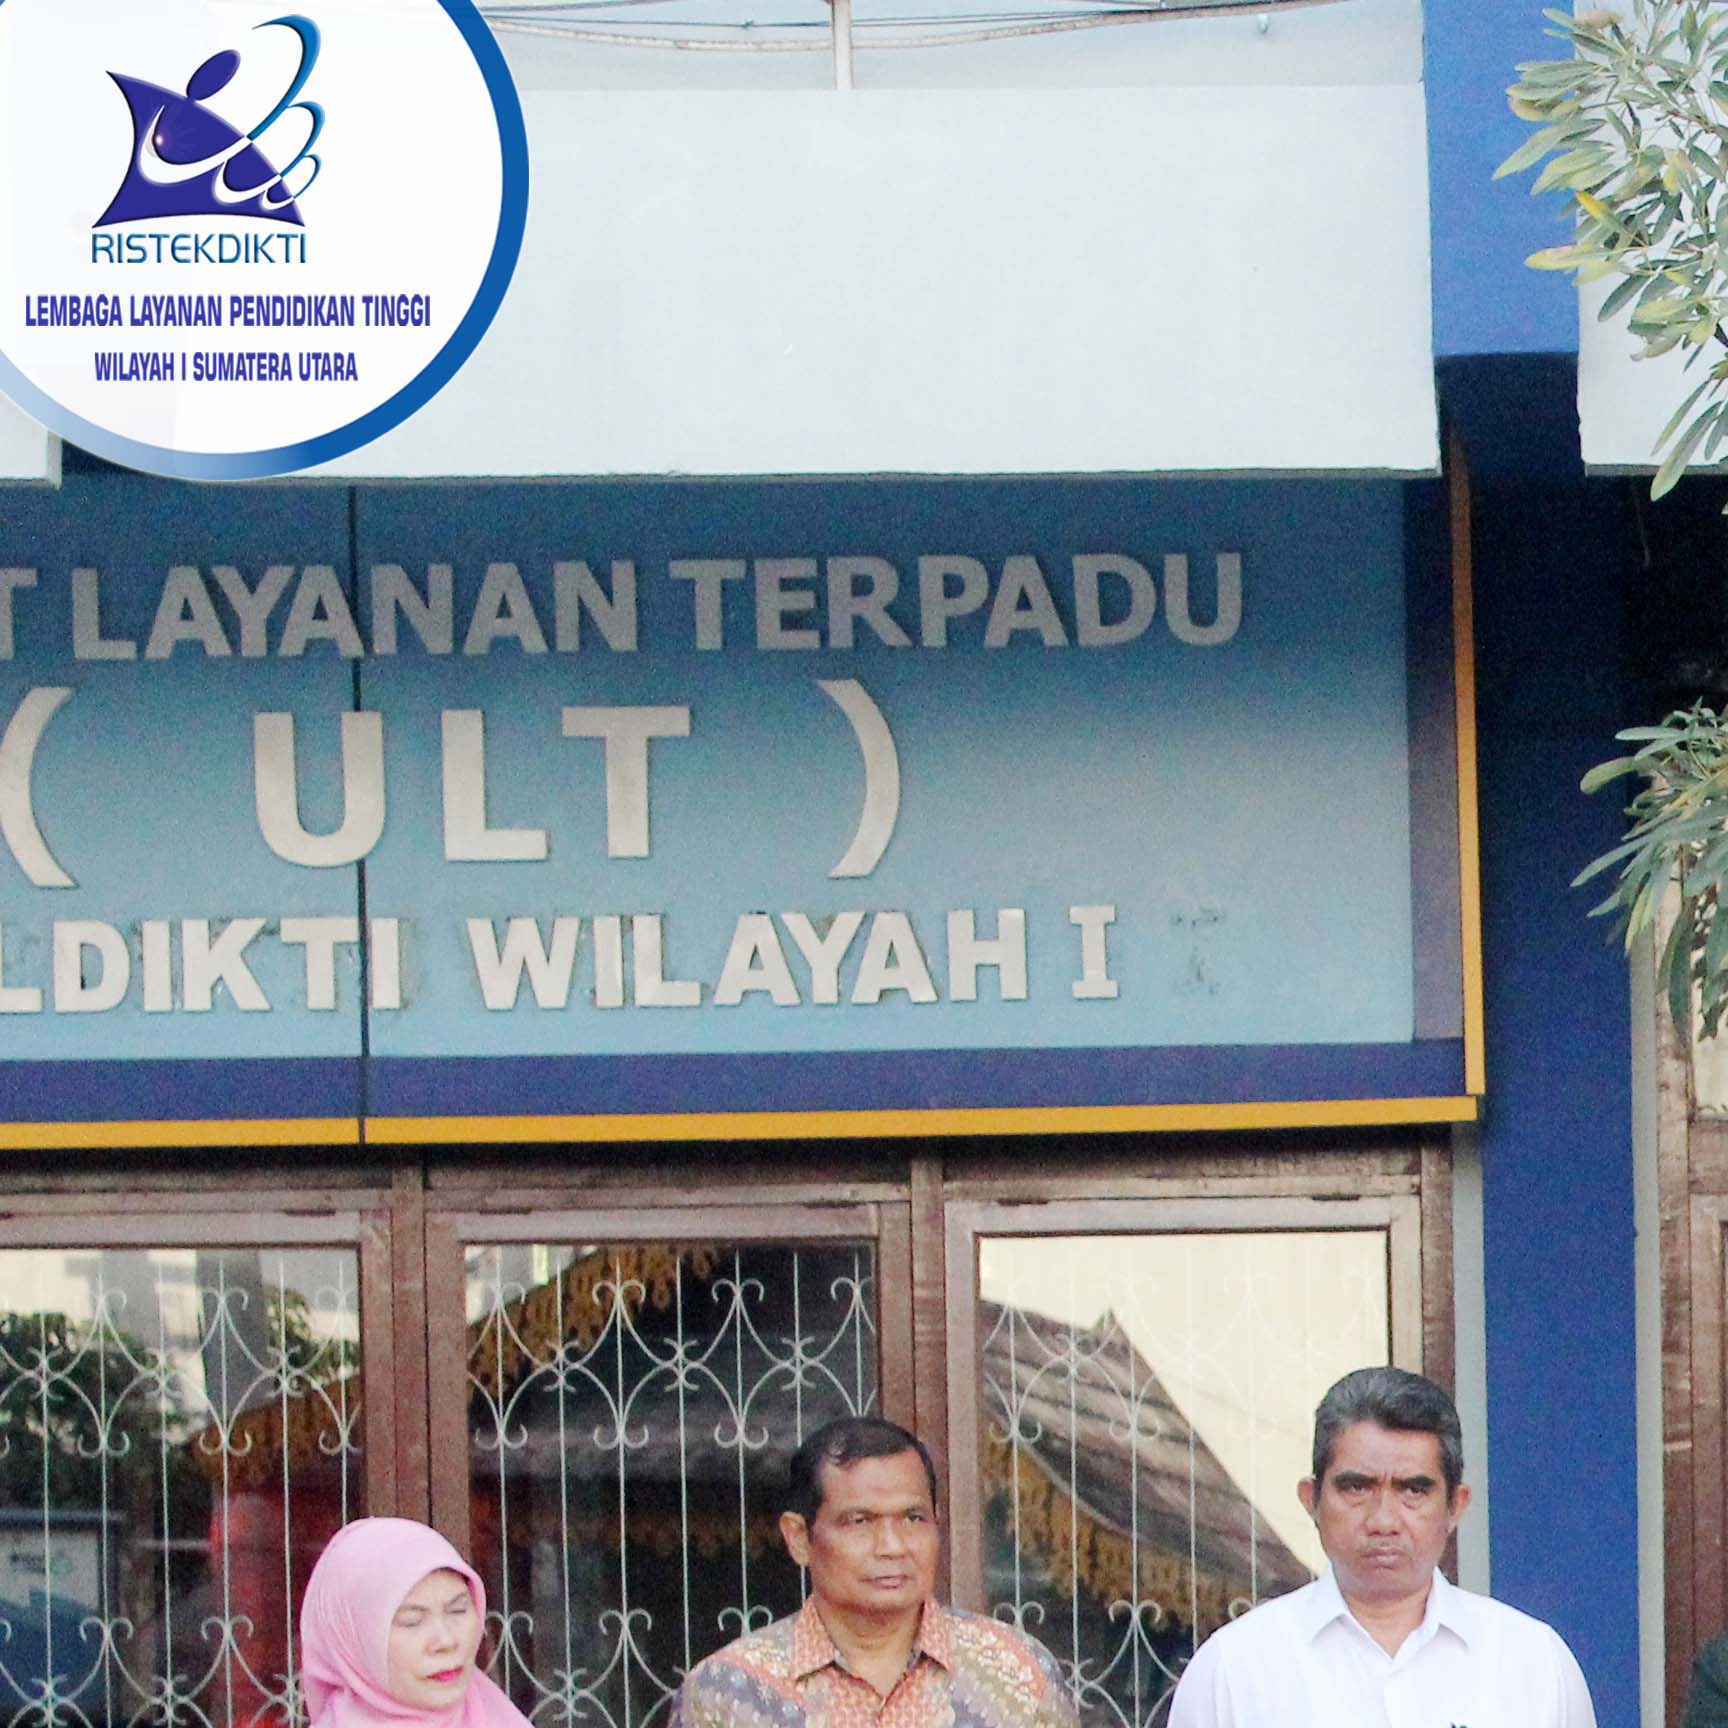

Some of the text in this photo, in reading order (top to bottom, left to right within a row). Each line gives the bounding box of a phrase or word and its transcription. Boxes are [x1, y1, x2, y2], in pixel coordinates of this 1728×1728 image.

[72, 560, 639, 660] LAYANAN
[669, 553, 1243, 652] TERPADU
[467, 908, 1029, 1010] WILAYAH
[1070, 904, 1118, 998] I
